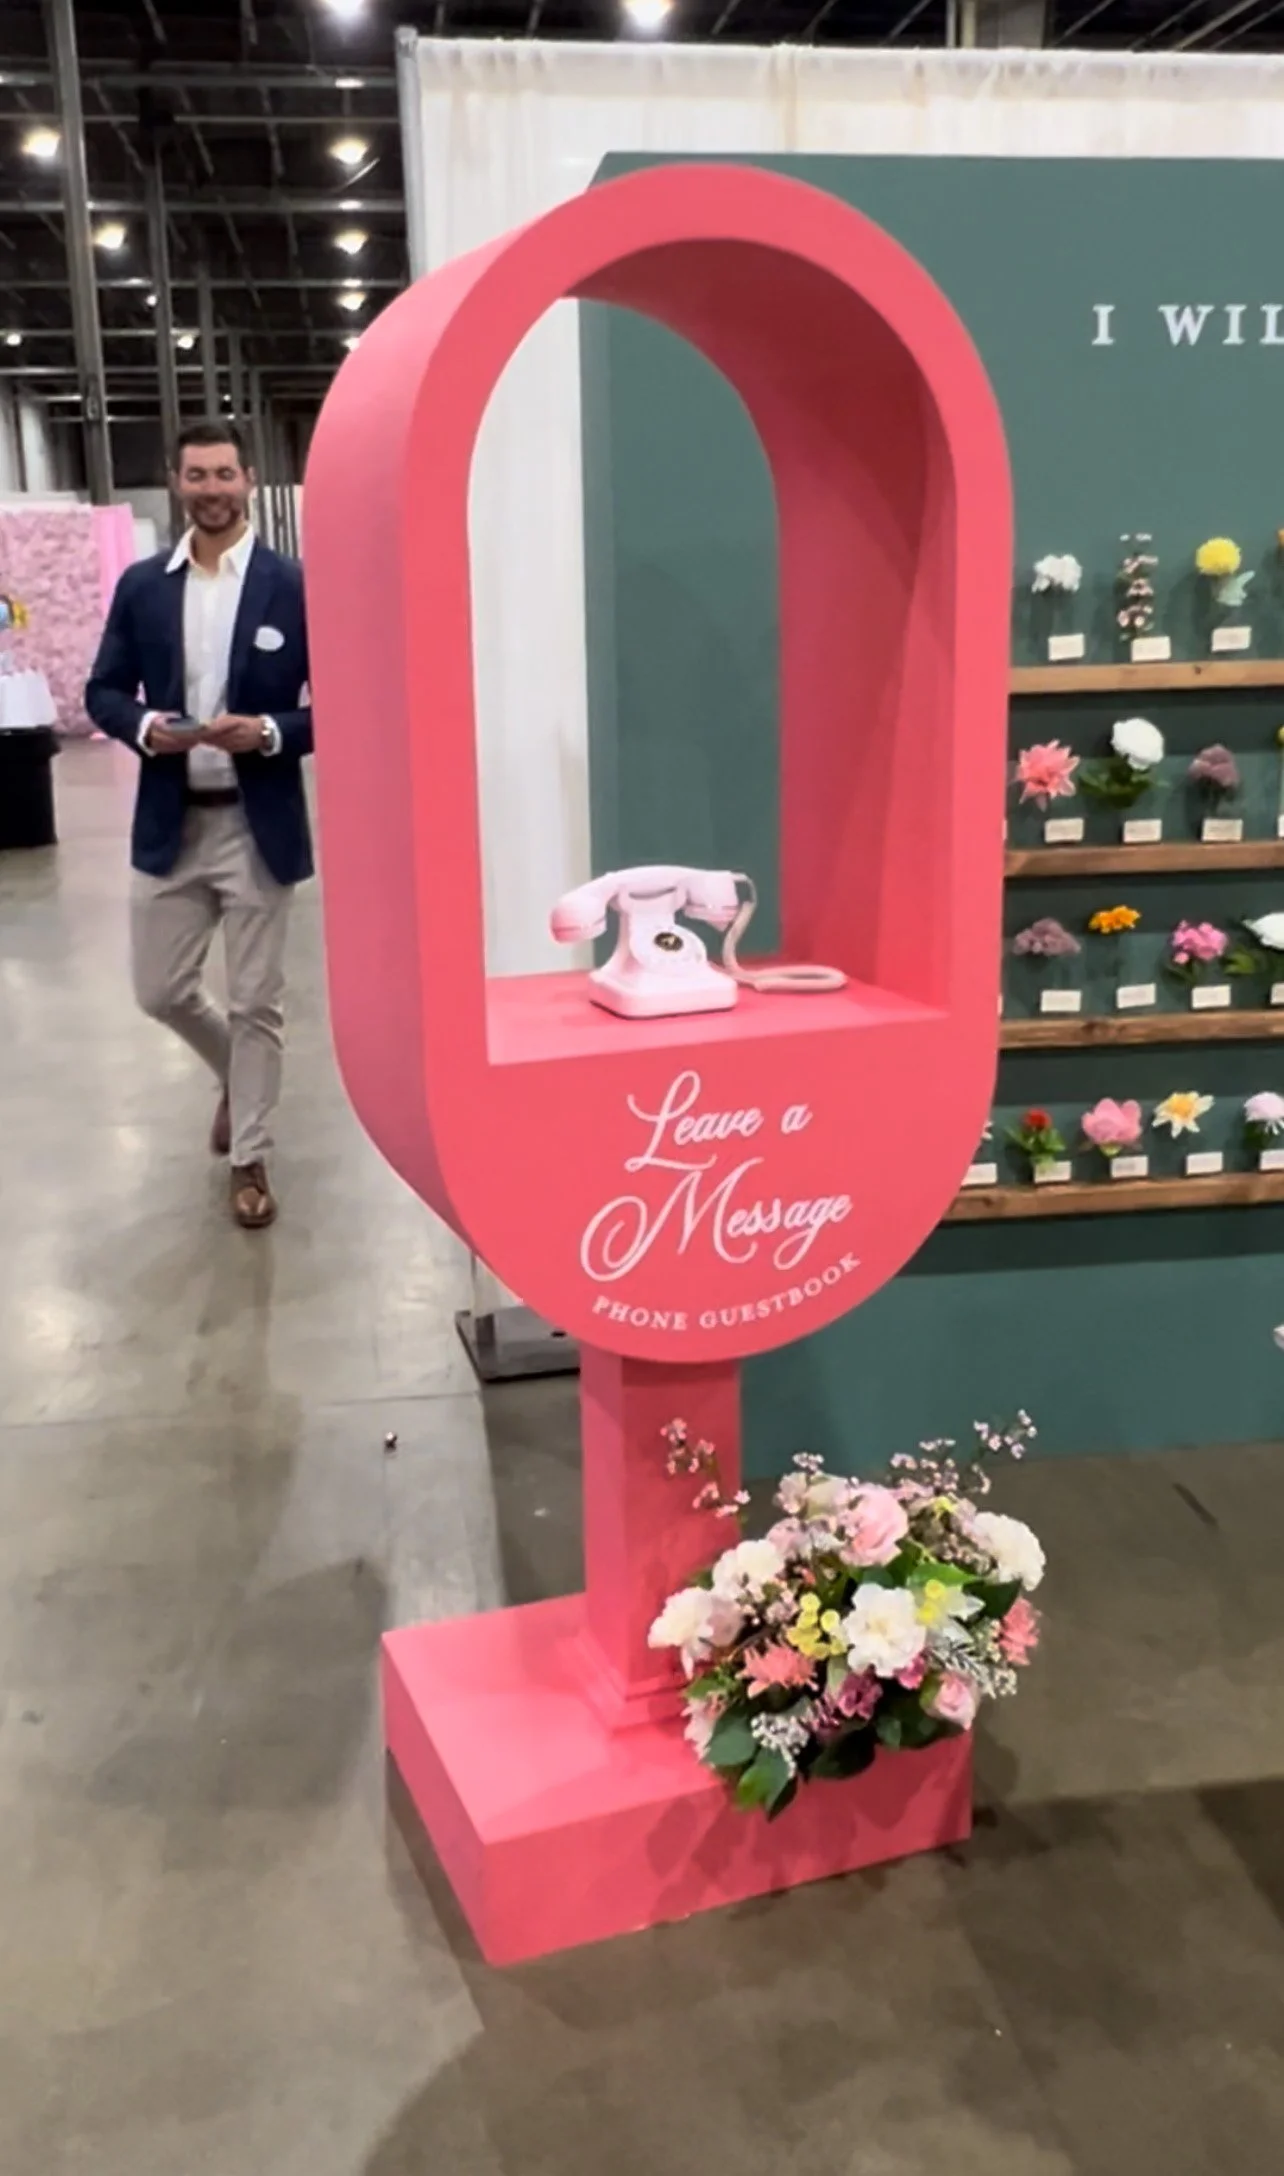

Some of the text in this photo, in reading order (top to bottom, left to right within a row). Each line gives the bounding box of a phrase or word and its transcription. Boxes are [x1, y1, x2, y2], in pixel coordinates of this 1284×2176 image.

[1092, 303, 1115, 346] I
[624, 1070, 812, 1172] Leave a
[580, 1157, 853, 1282] Message
[592, 1252, 861, 1330] PHONE GUESTBOOK
